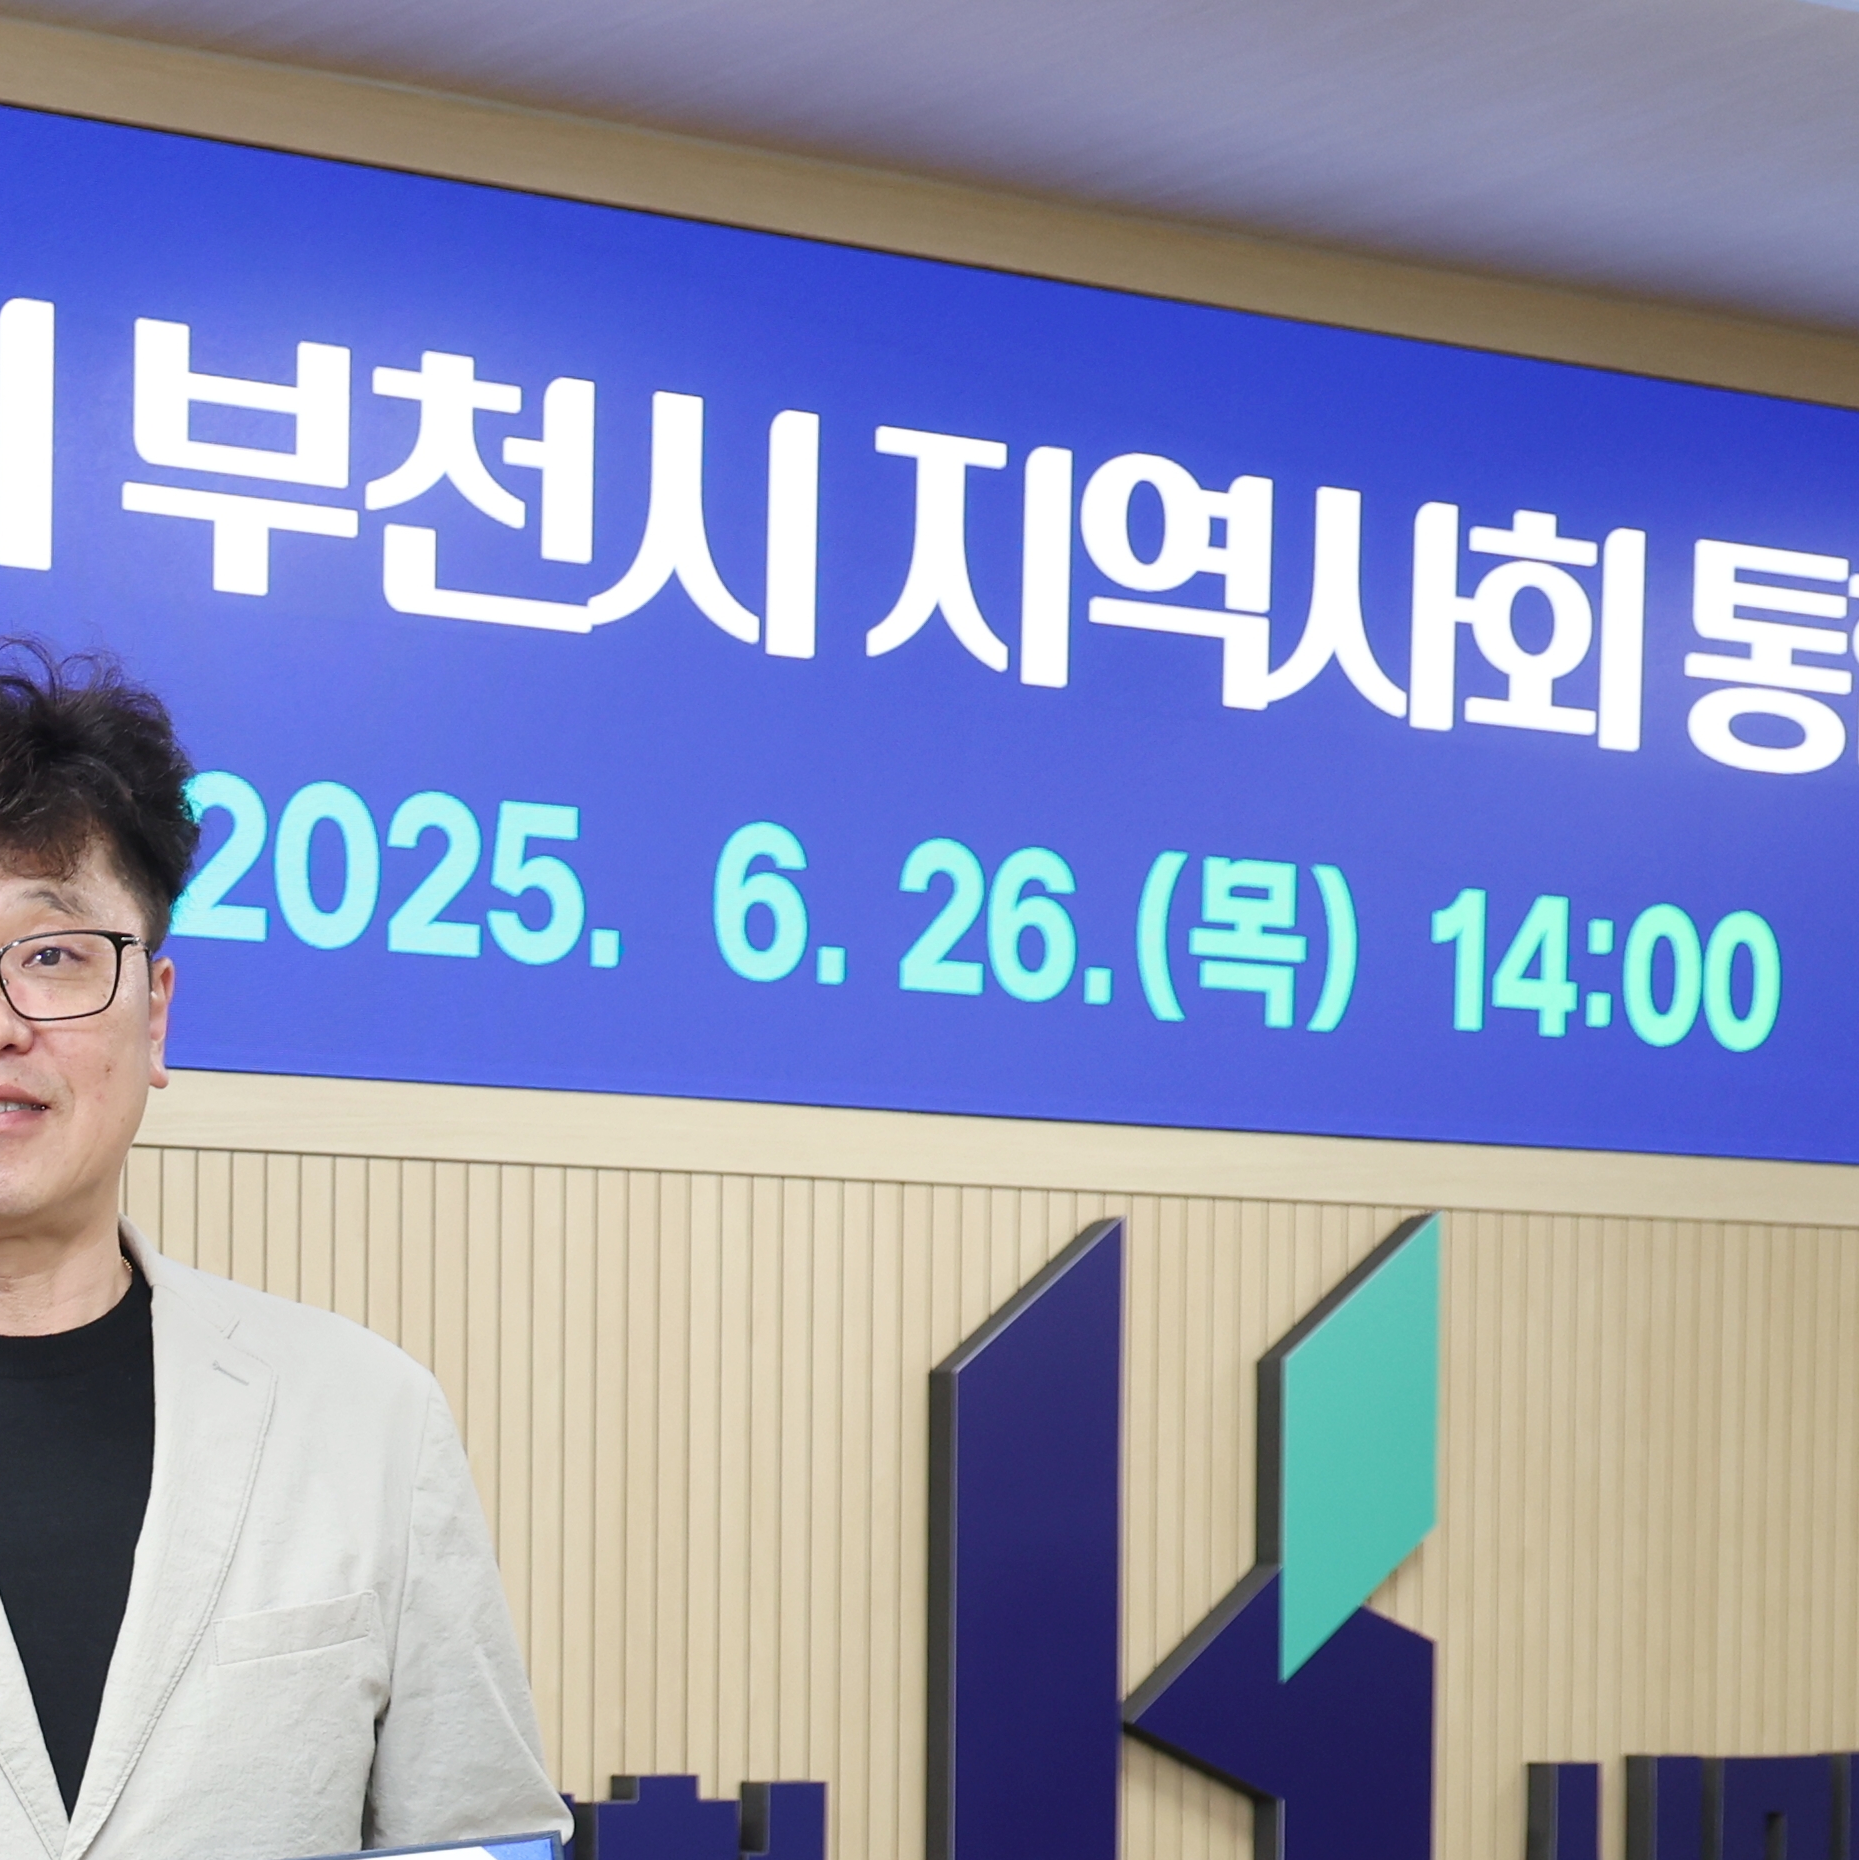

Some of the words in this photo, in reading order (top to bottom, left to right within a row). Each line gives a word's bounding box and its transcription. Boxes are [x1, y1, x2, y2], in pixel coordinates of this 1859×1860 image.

[122, 317, 819, 659] 부천시
[866, 426, 1645, 751] 지역사회
[1683, 538, 1859, 775] 통
[169, 770, 621, 969] 2025.
[712, 820, 847, 986] 6.
[1430, 887, 1782, 1053] 14:00
